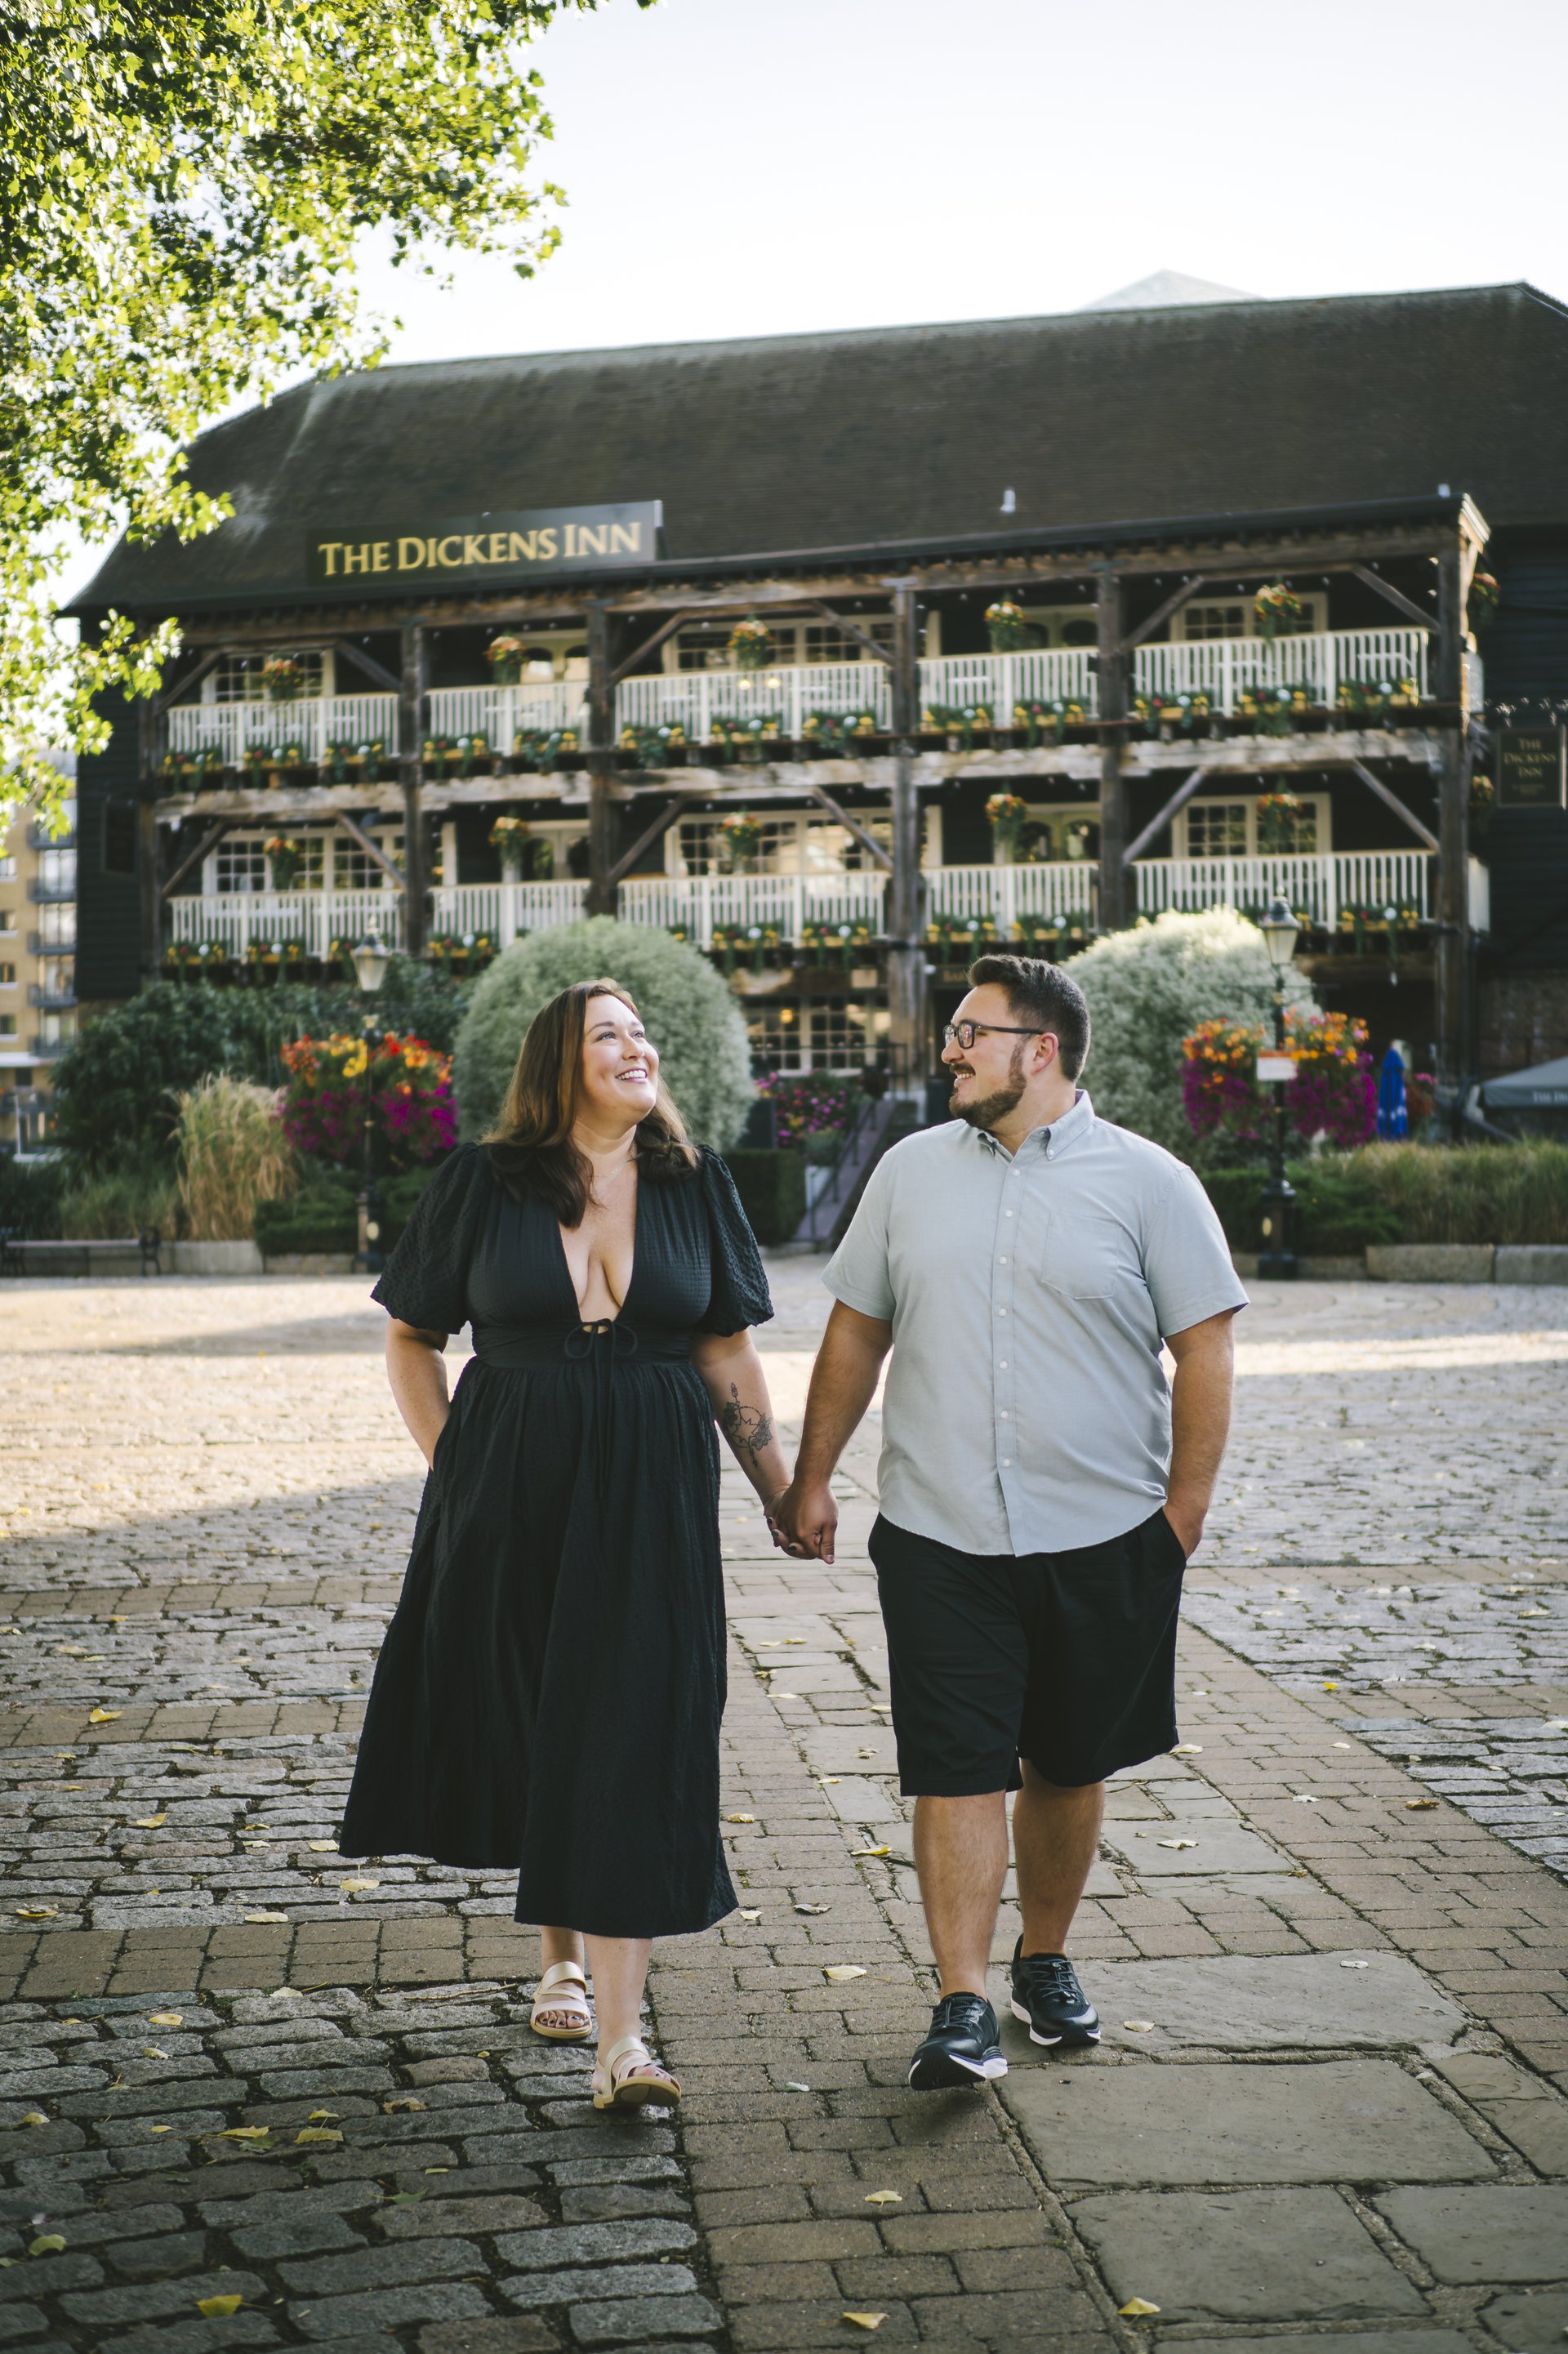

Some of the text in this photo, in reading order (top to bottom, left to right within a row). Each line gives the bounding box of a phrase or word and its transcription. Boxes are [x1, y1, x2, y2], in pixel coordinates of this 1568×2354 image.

[318, 522, 642, 576] THE DICKENS INN
[1517, 738, 1542, 751] THE
[1503, 752, 1556, 765] DICKENS
[1518, 766, 1542, 778] INN
